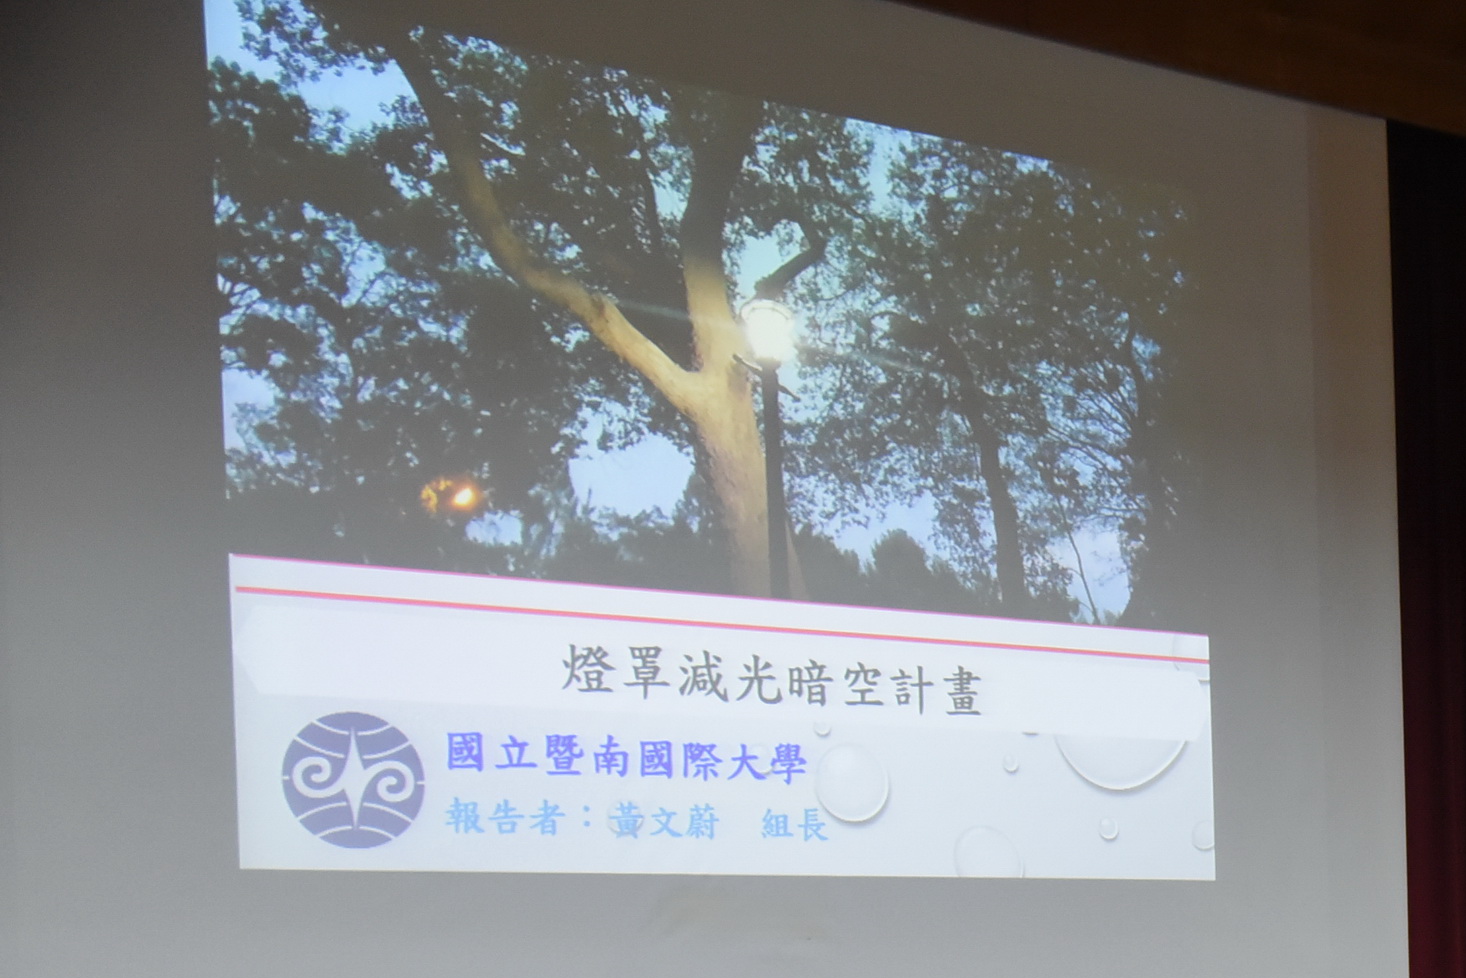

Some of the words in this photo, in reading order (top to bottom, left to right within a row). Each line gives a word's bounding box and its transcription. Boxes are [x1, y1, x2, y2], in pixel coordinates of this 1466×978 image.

[562, 643, 982, 716] 燈罩減光暗空計畫
[445, 732, 807, 785] 國立暨南國際大學
[444, 797, 720, 840] 報告者：黃文蔚
[761, 808, 830, 842] 組長
